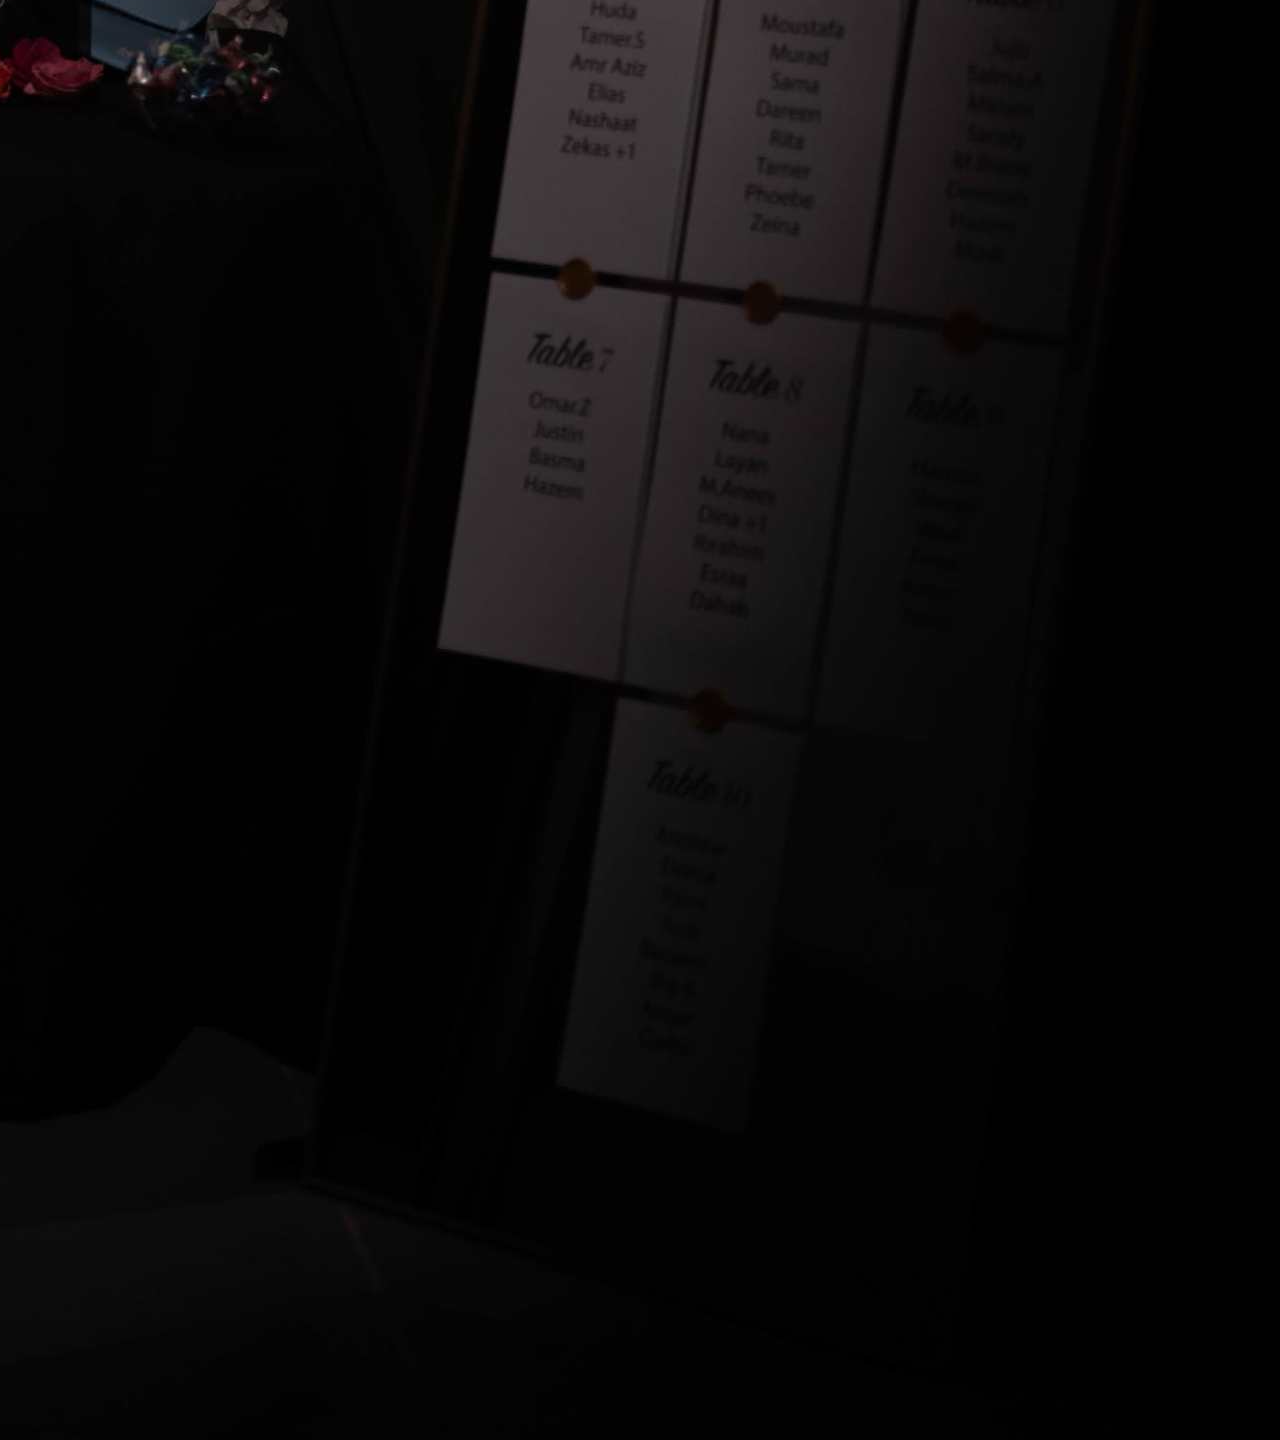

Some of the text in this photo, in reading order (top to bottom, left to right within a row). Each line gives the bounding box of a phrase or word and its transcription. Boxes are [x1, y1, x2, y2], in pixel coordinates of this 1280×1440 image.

[590, 0, 637, 21] Huda
[527, 332, 616, 374] Table 7
[709, 358, 781, 399] Table
[647, 760, 719, 803] Table
